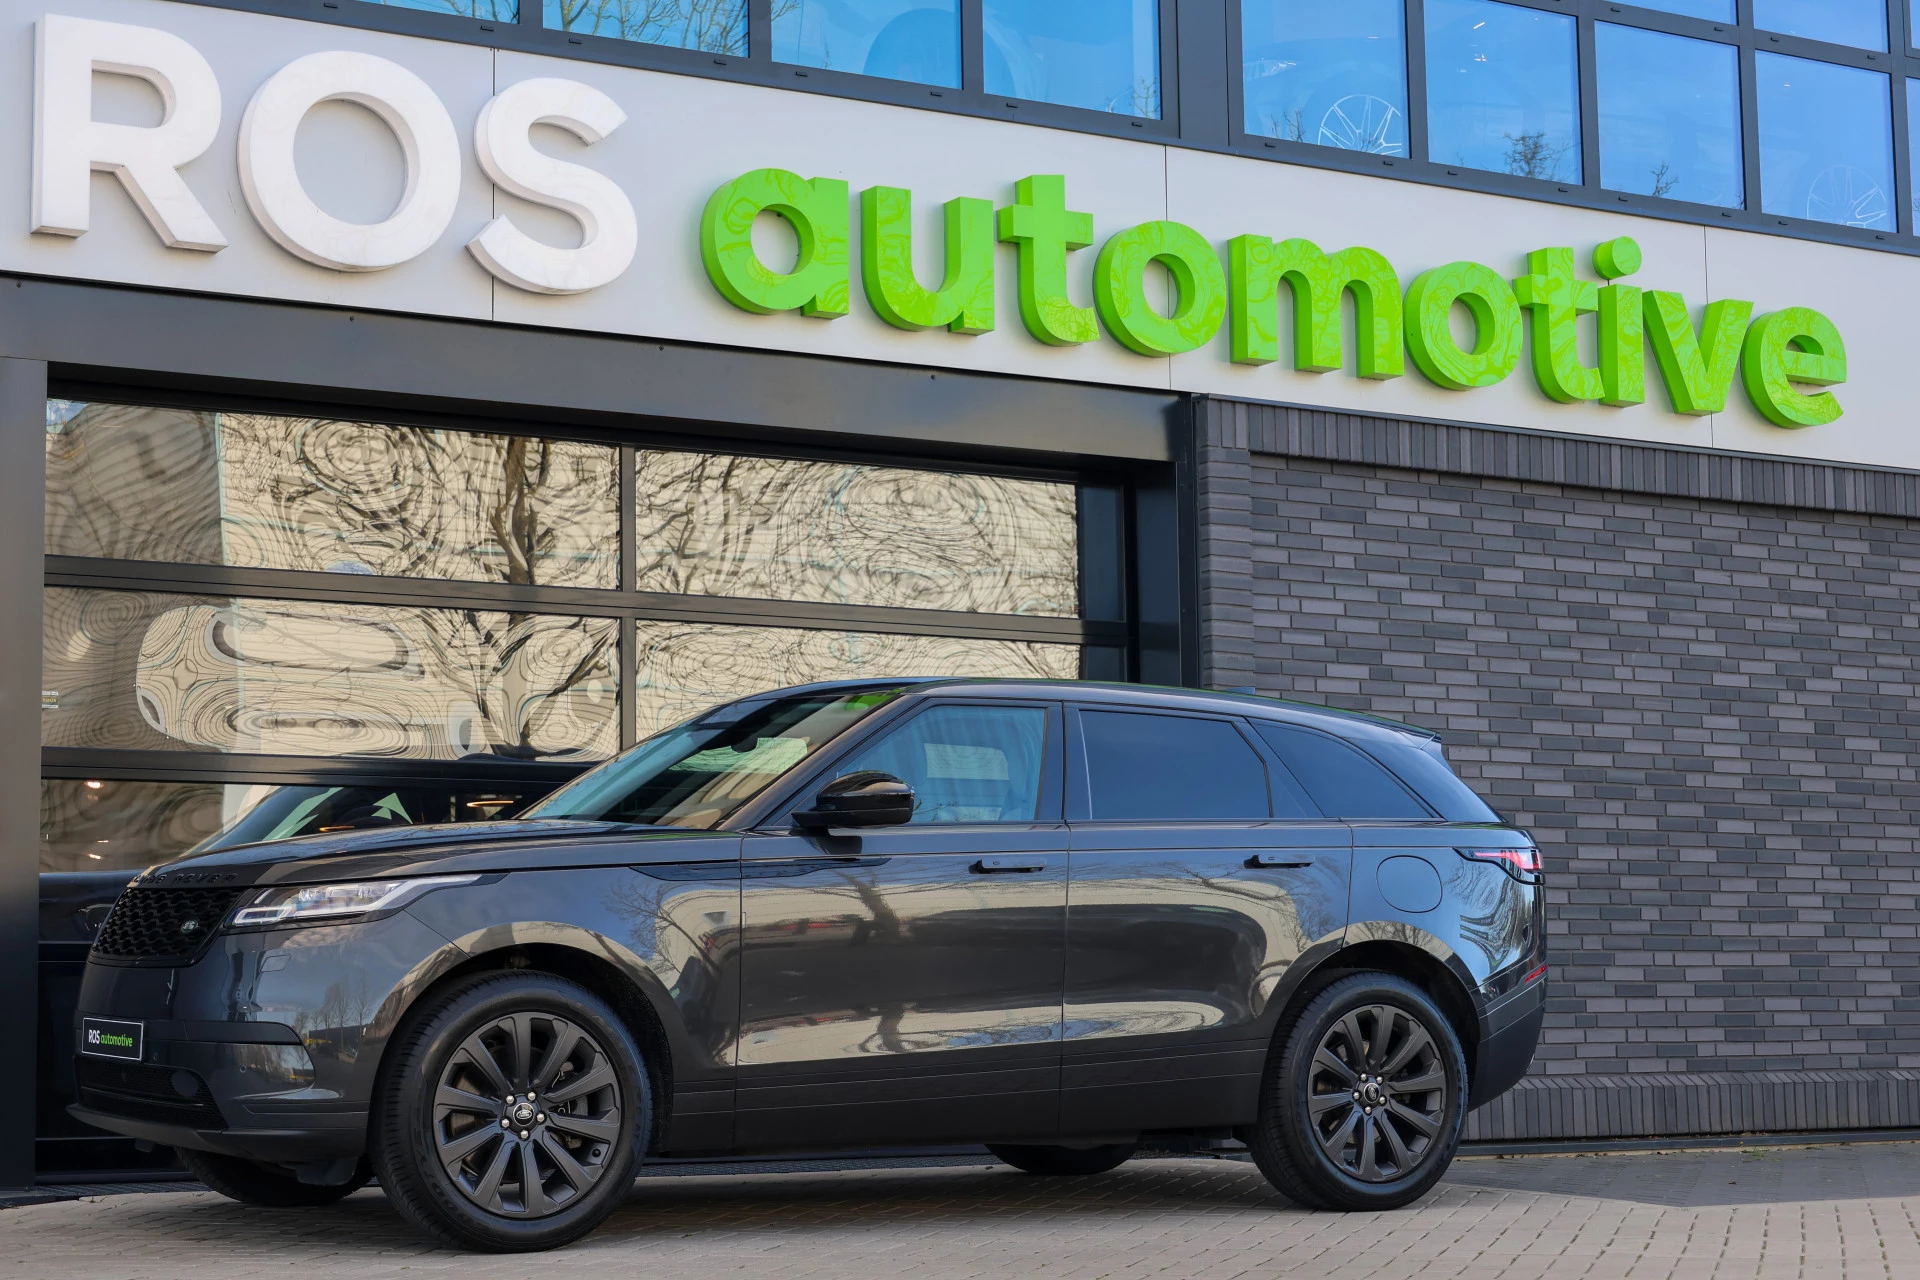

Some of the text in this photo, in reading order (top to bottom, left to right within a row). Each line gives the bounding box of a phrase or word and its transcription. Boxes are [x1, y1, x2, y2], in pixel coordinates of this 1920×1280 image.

[31, 13, 1848, 430] ROS automotive
[88, 1029, 133, 1047] ROS automotive
